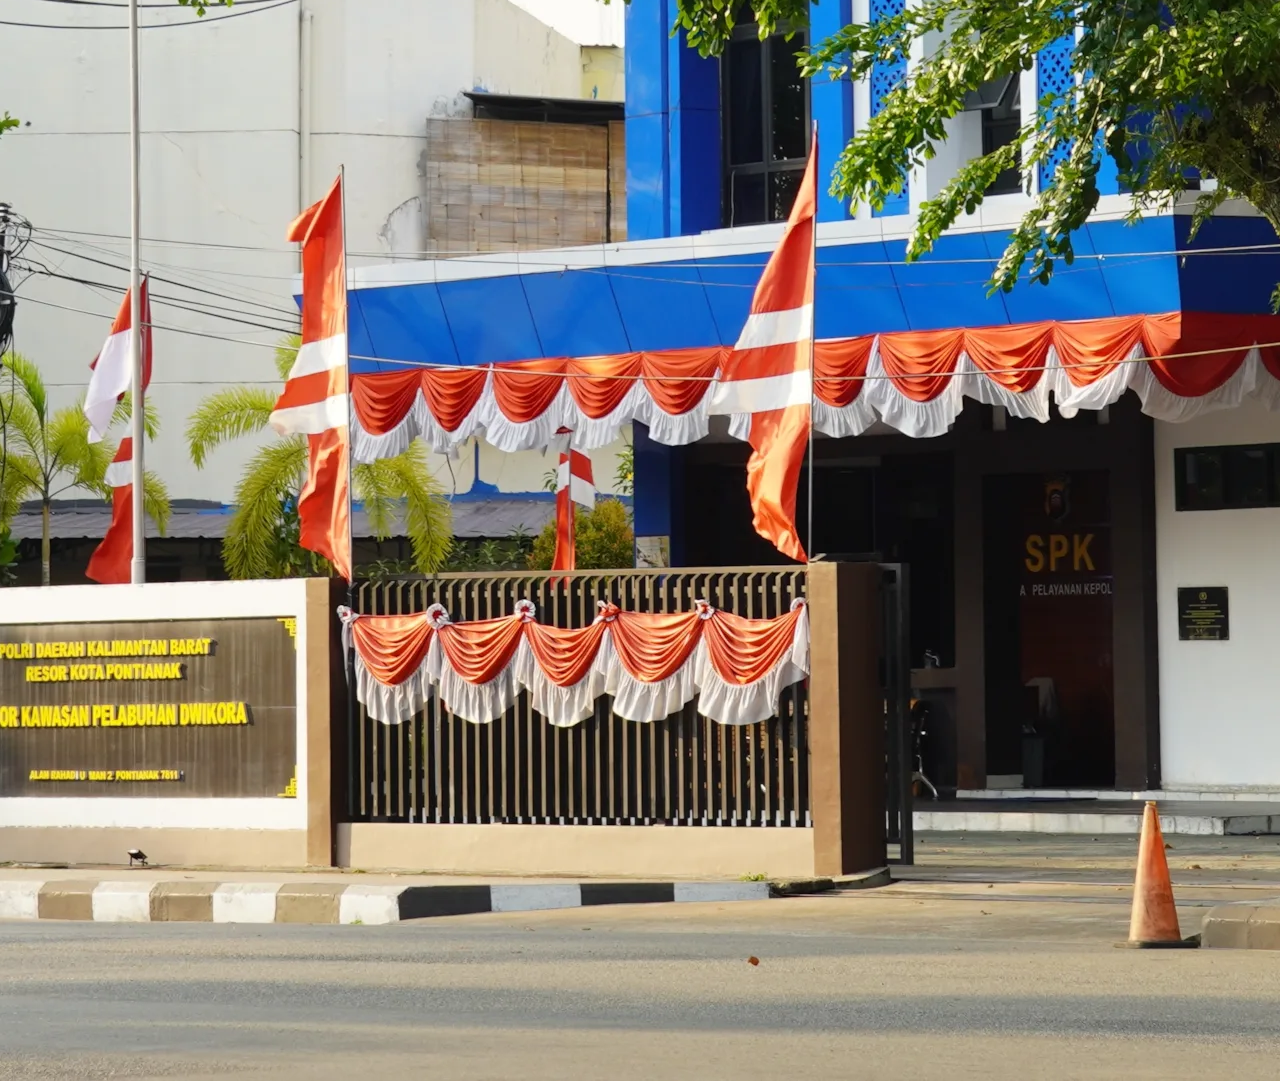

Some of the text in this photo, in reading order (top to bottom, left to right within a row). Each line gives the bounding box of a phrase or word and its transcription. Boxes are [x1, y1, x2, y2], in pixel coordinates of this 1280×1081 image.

[1025, 533, 1096, 572] SPK
[1032, 583, 1082, 596] PELAYANAN
[1084, 582, 1112, 595] KEPOL
[36, 641, 84, 658] DAERAH
[87, 639, 167, 657] KALIMANTAN
[170, 638, 211, 655] BARAT
[26, 663, 182, 682] RESOR KOTA PONTIANAK
[21, 705, 89, 727] KAWASAN
[92, 704, 176, 727] PELABUHAN
[180, 702, 247, 725] DWIKORA
[107, 770, 113, 780] 2
[115, 769, 159, 781] PONTIANAK
